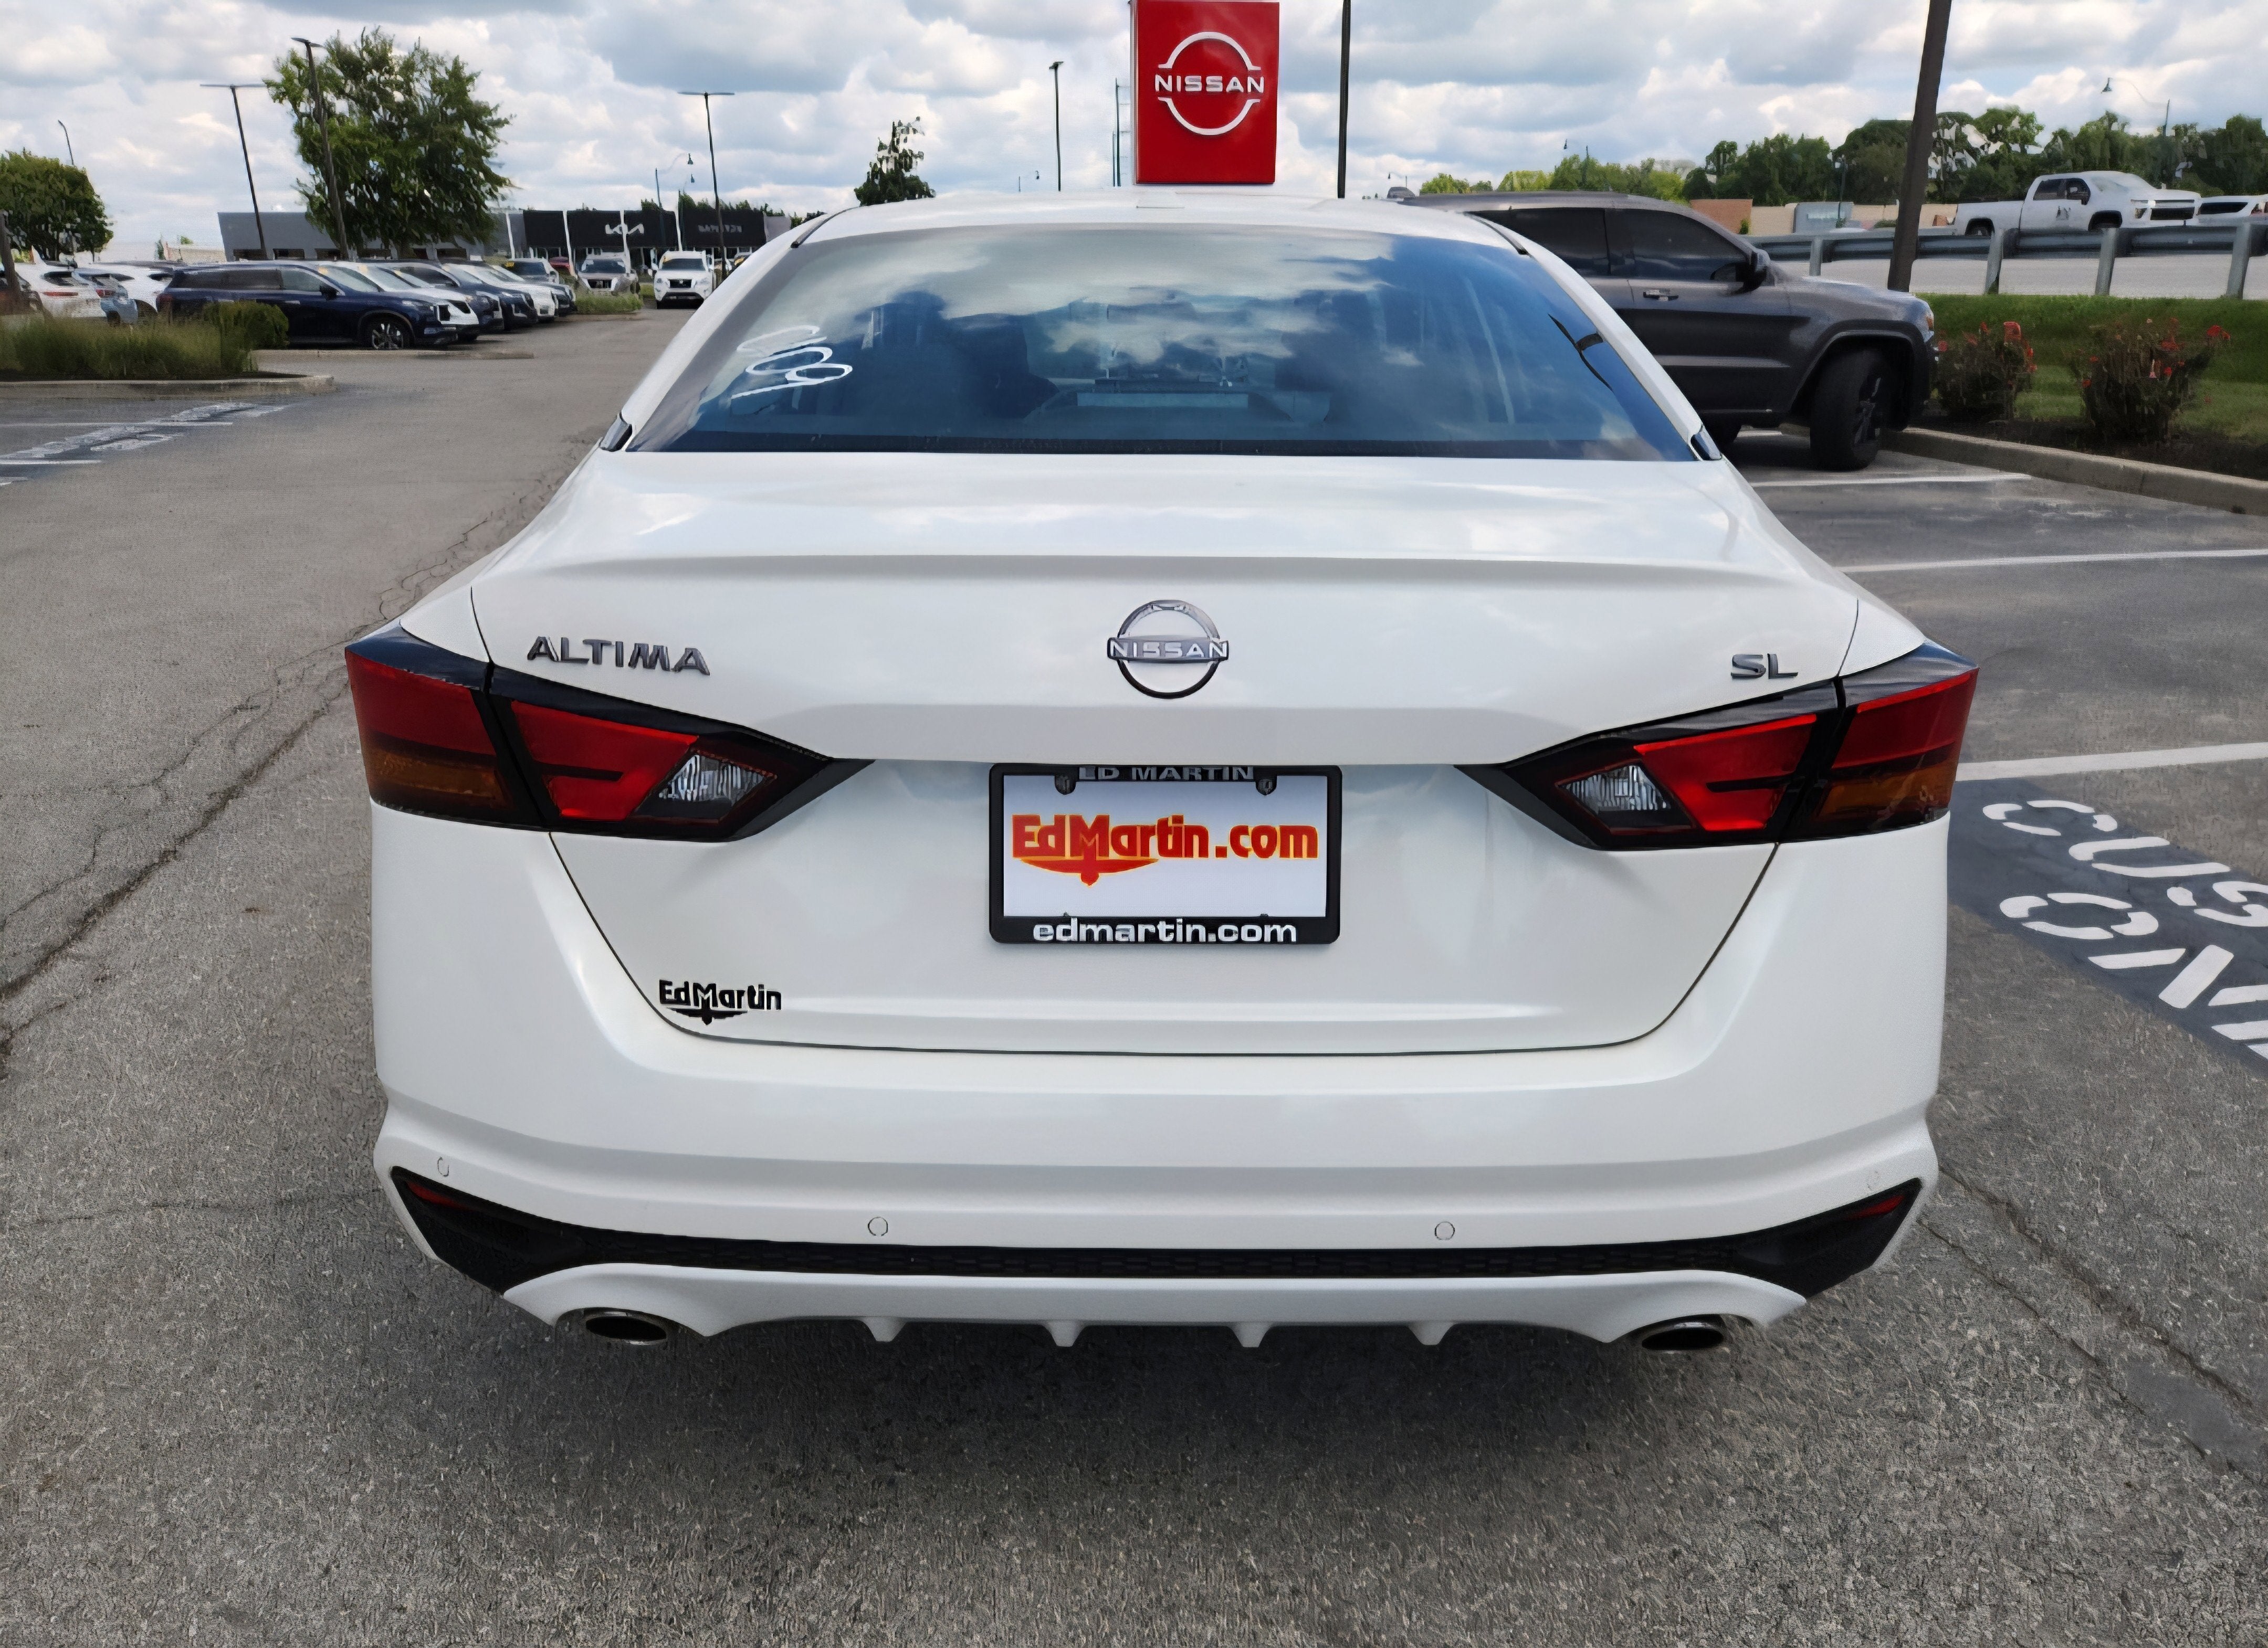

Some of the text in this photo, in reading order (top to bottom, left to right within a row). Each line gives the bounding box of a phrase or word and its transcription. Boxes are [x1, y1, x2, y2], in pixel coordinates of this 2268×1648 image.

[1155, 74, 1264, 93] NISSAN
[527, 636, 710, 676] ALTIMA
[1109, 641, 1228, 659] NISSAN
[1731, 653, 1799, 679] SL
[1131, 766, 1254, 780] MARTIN
[1012, 814, 1318, 860] EdMartin.com
[1033, 918, 1297, 943] edmartin.com
[659, 979, 781, 1010] EdMartin
